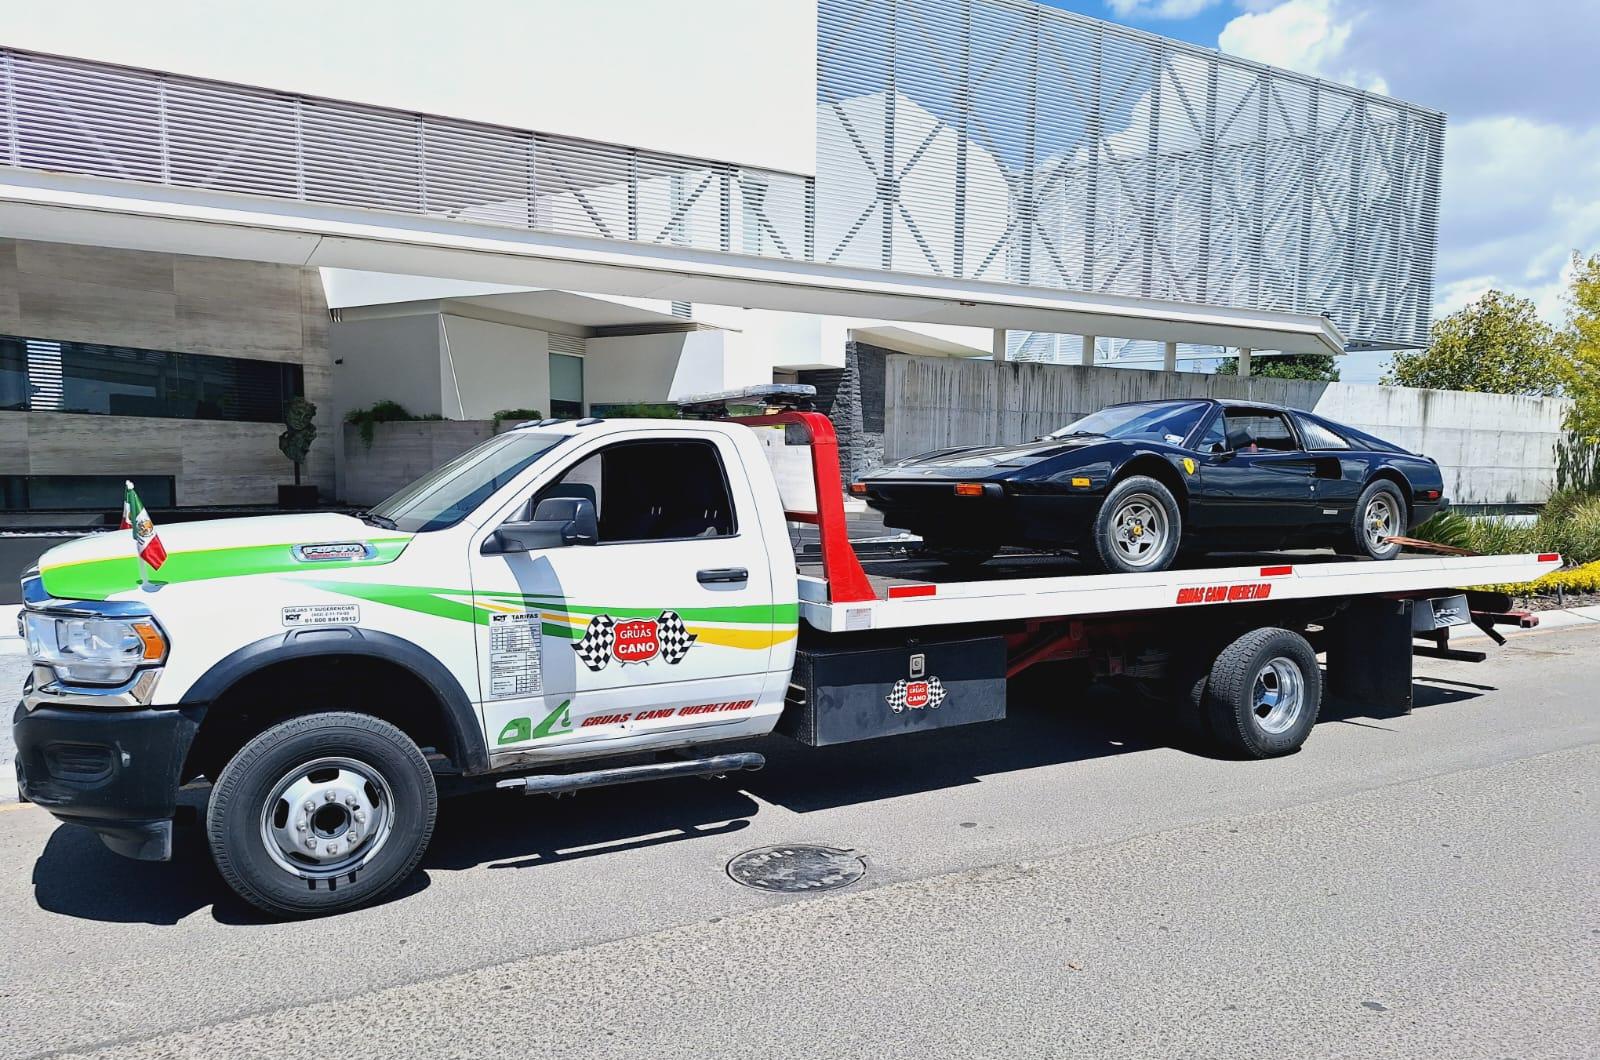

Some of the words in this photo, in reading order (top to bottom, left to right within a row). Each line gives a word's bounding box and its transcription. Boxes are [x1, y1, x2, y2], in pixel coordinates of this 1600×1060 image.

[620, 628, 652, 639] GRUAS
[619, 642, 655, 654] CANO
[581, 712, 632, 728] GRUAS
[634, 707, 676, 721] CANO
[677, 700, 754, 717] QUERETARO
